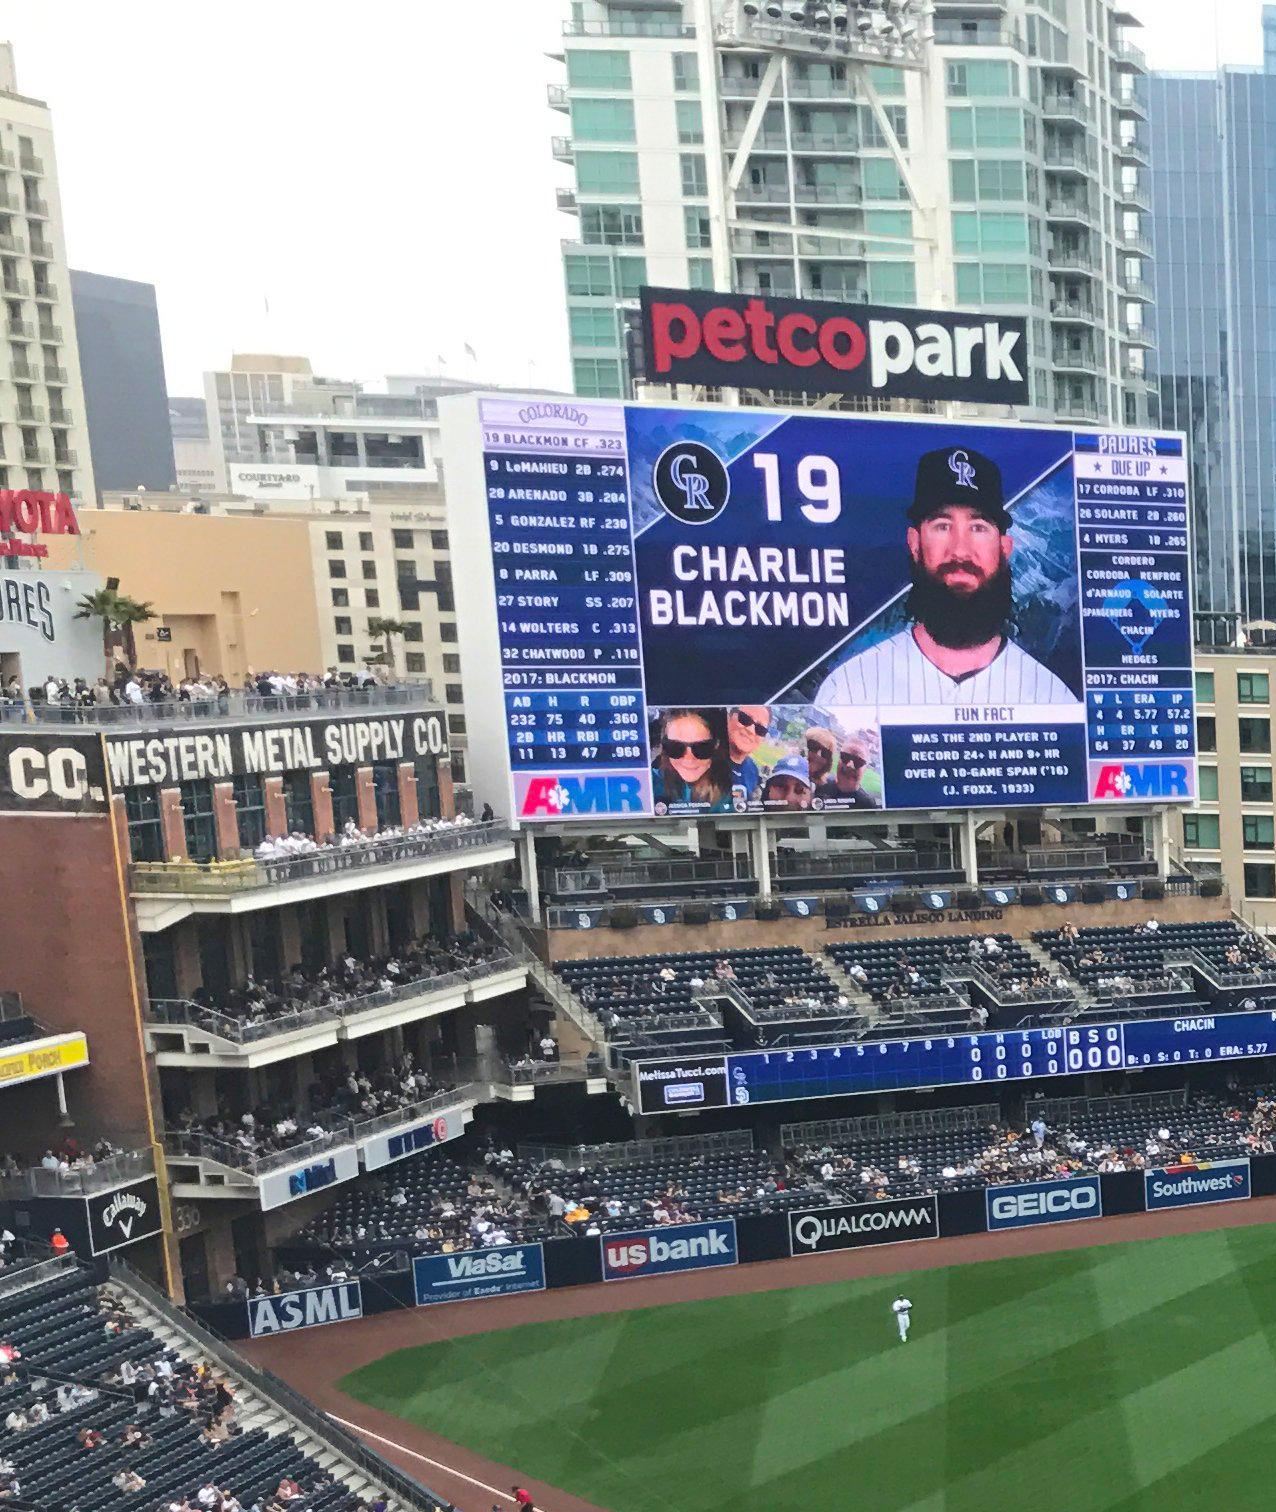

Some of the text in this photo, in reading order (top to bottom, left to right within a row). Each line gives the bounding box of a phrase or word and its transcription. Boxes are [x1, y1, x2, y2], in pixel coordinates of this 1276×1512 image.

[518, 403, 588, 426] COLORADO
[484, 432, 622, 449] 19 BLACKMON CF .323
[1098, 435, 1157, 457] PADRES
[575, 465, 591, 475] 2B
[597, 466, 624, 476] .274
[1111, 460, 1150, 477] DUE UP
[753, 453, 842, 523] 19
[494, 542, 630, 555] 20 DESMOND 1B .275
[673, 545, 846, 583] CHARLIE
[500, 596, 634, 608] 27 STORY SS .207
[649, 589, 850, 627] BLACKMON
[504, 673, 616, 684] 2017: BLACKMON
[1087, 674, 1158, 685] 2017: CHACIN
[954, 707, 1015, 721] FUN FACT
[912, 732, 1058, 744] WAS THE 2ND PLAYER TO
[105, 716, 448, 787] WESTERN METAL SUPPLY CO.
[7, 746, 104, 802] CO.
[1094, 764, 1189, 799] AMR
[522, 776, 643, 816] AMR
[947, 909, 1003, 922] LANDING
[1174, 1019, 1215, 1033] CHACIN
[1219, 1043, 1268, 1056] ERA: 5.77
[1153, 1173, 1233, 1198] Southwest
[102, 1192, 147, 1228] Callaway
[991, 1186, 1097, 1220] GEICO
[795, 1207, 932, 1249] QUALCOMM
[447, 1250, 525, 1279] ViaSat
[253, 1285, 361, 1335] ASML
